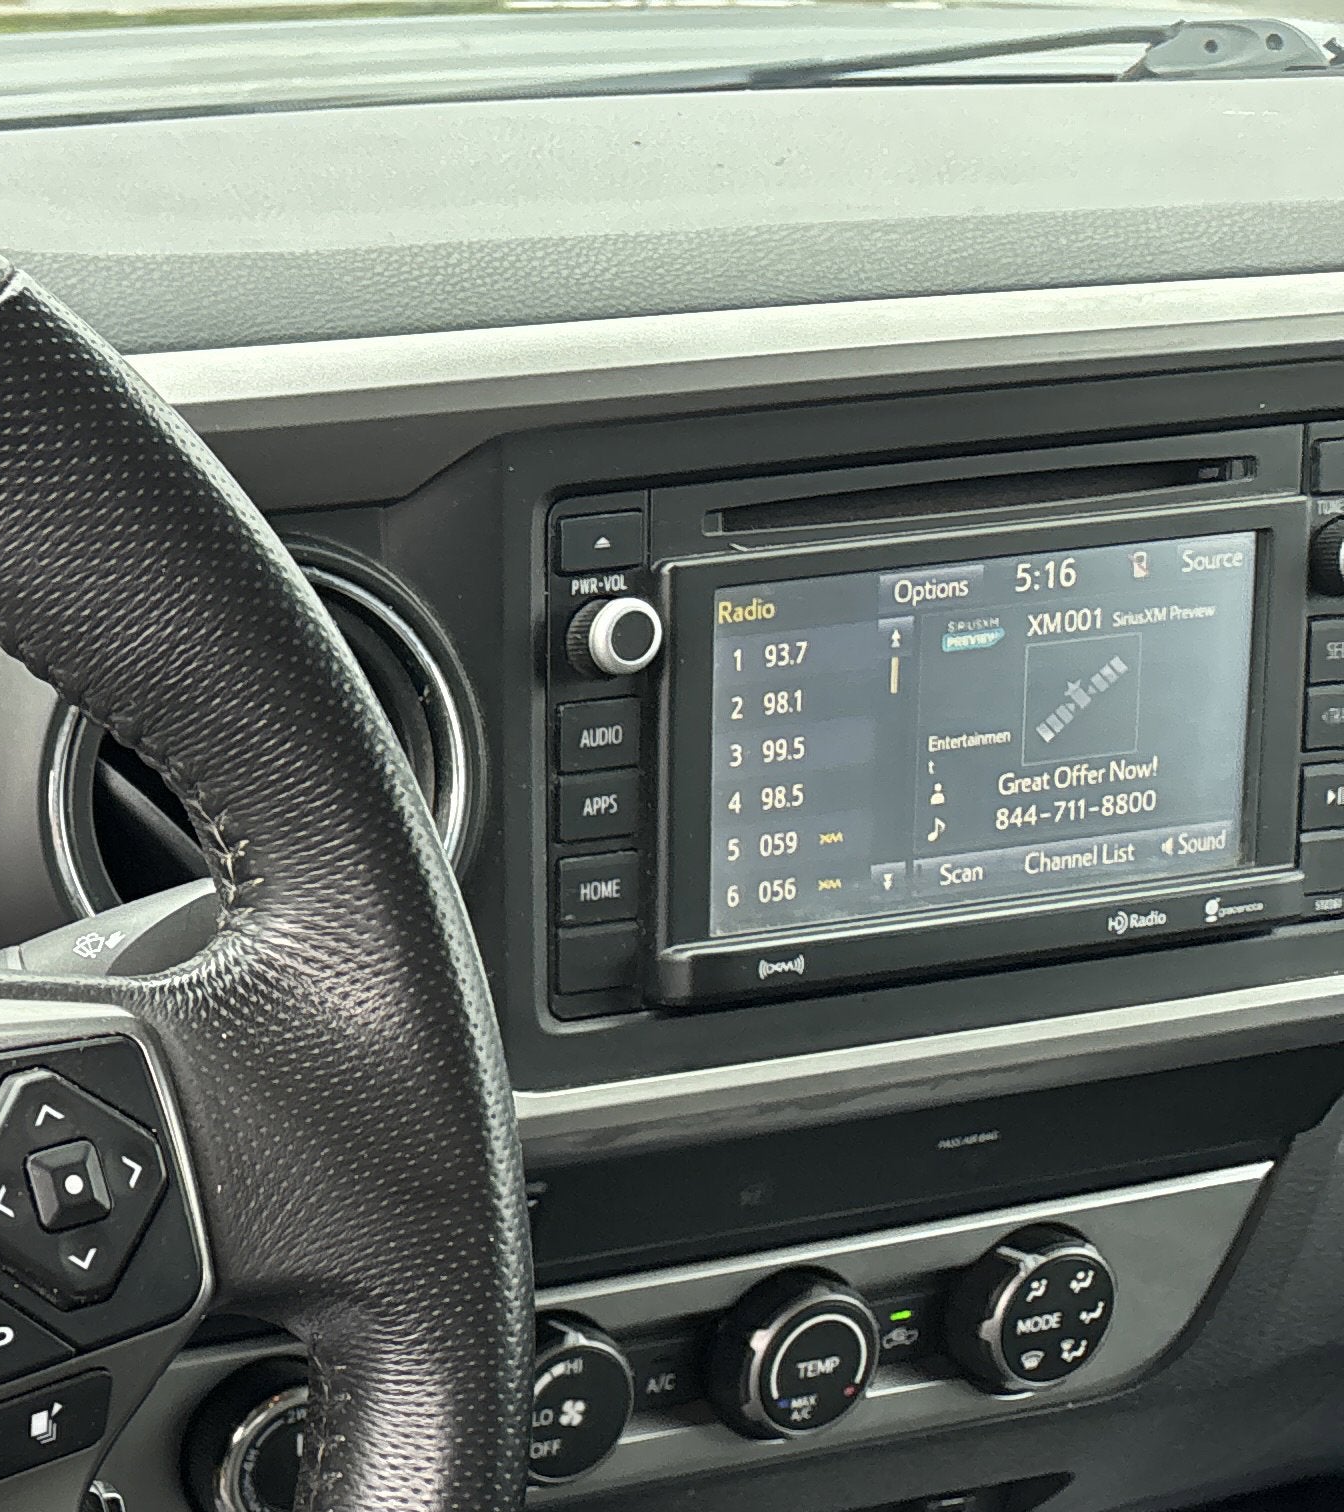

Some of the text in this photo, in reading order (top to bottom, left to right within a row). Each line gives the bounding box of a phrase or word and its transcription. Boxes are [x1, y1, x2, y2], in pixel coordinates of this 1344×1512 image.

[1181, 549, 1243, 573] Source
[1015, 557, 1077, 592] 5:16
[894, 578, 968, 606] Options
[717, 597, 777, 625] Radio
[1112, 609, 1167, 628] SiriusXM
[1169, 603, 1216, 620] Preview
[733, 641, 808, 672] 1 93.7
[730, 689, 802, 720] 2 98.1
[579, 725, 623, 749] AUDIO
[928, 730, 1012, 752] Entertainmen
[728, 736, 805, 767] 3 99.5
[998, 756, 1158, 796] Great Offer Now!
[582, 794, 619, 817] APPS
[728, 783, 804, 814] 4 98.5
[995, 790, 1157, 830] 844-711-8800
[727, 838, 740, 861] 5
[759, 831, 798, 857] 059
[1178, 829, 1226, 855] Sound
[1024, 843, 1135, 875] Channel List
[939, 863, 983, 887] Scan
[580, 878, 621, 901] HOME
[726, 884, 740, 907] 6
[758, 877, 797, 904] 056
[1129, 912, 1167, 929] Radio
[1016, 1311, 1062, 1336] MODE
[566, 1358, 583, 1375] HI
[796, 1356, 840, 1379] TEMP
[646, 1373, 676, 1394] A/C
[532, 1408, 554, 1427] LO
[530, 1439, 562, 1459] OFF
